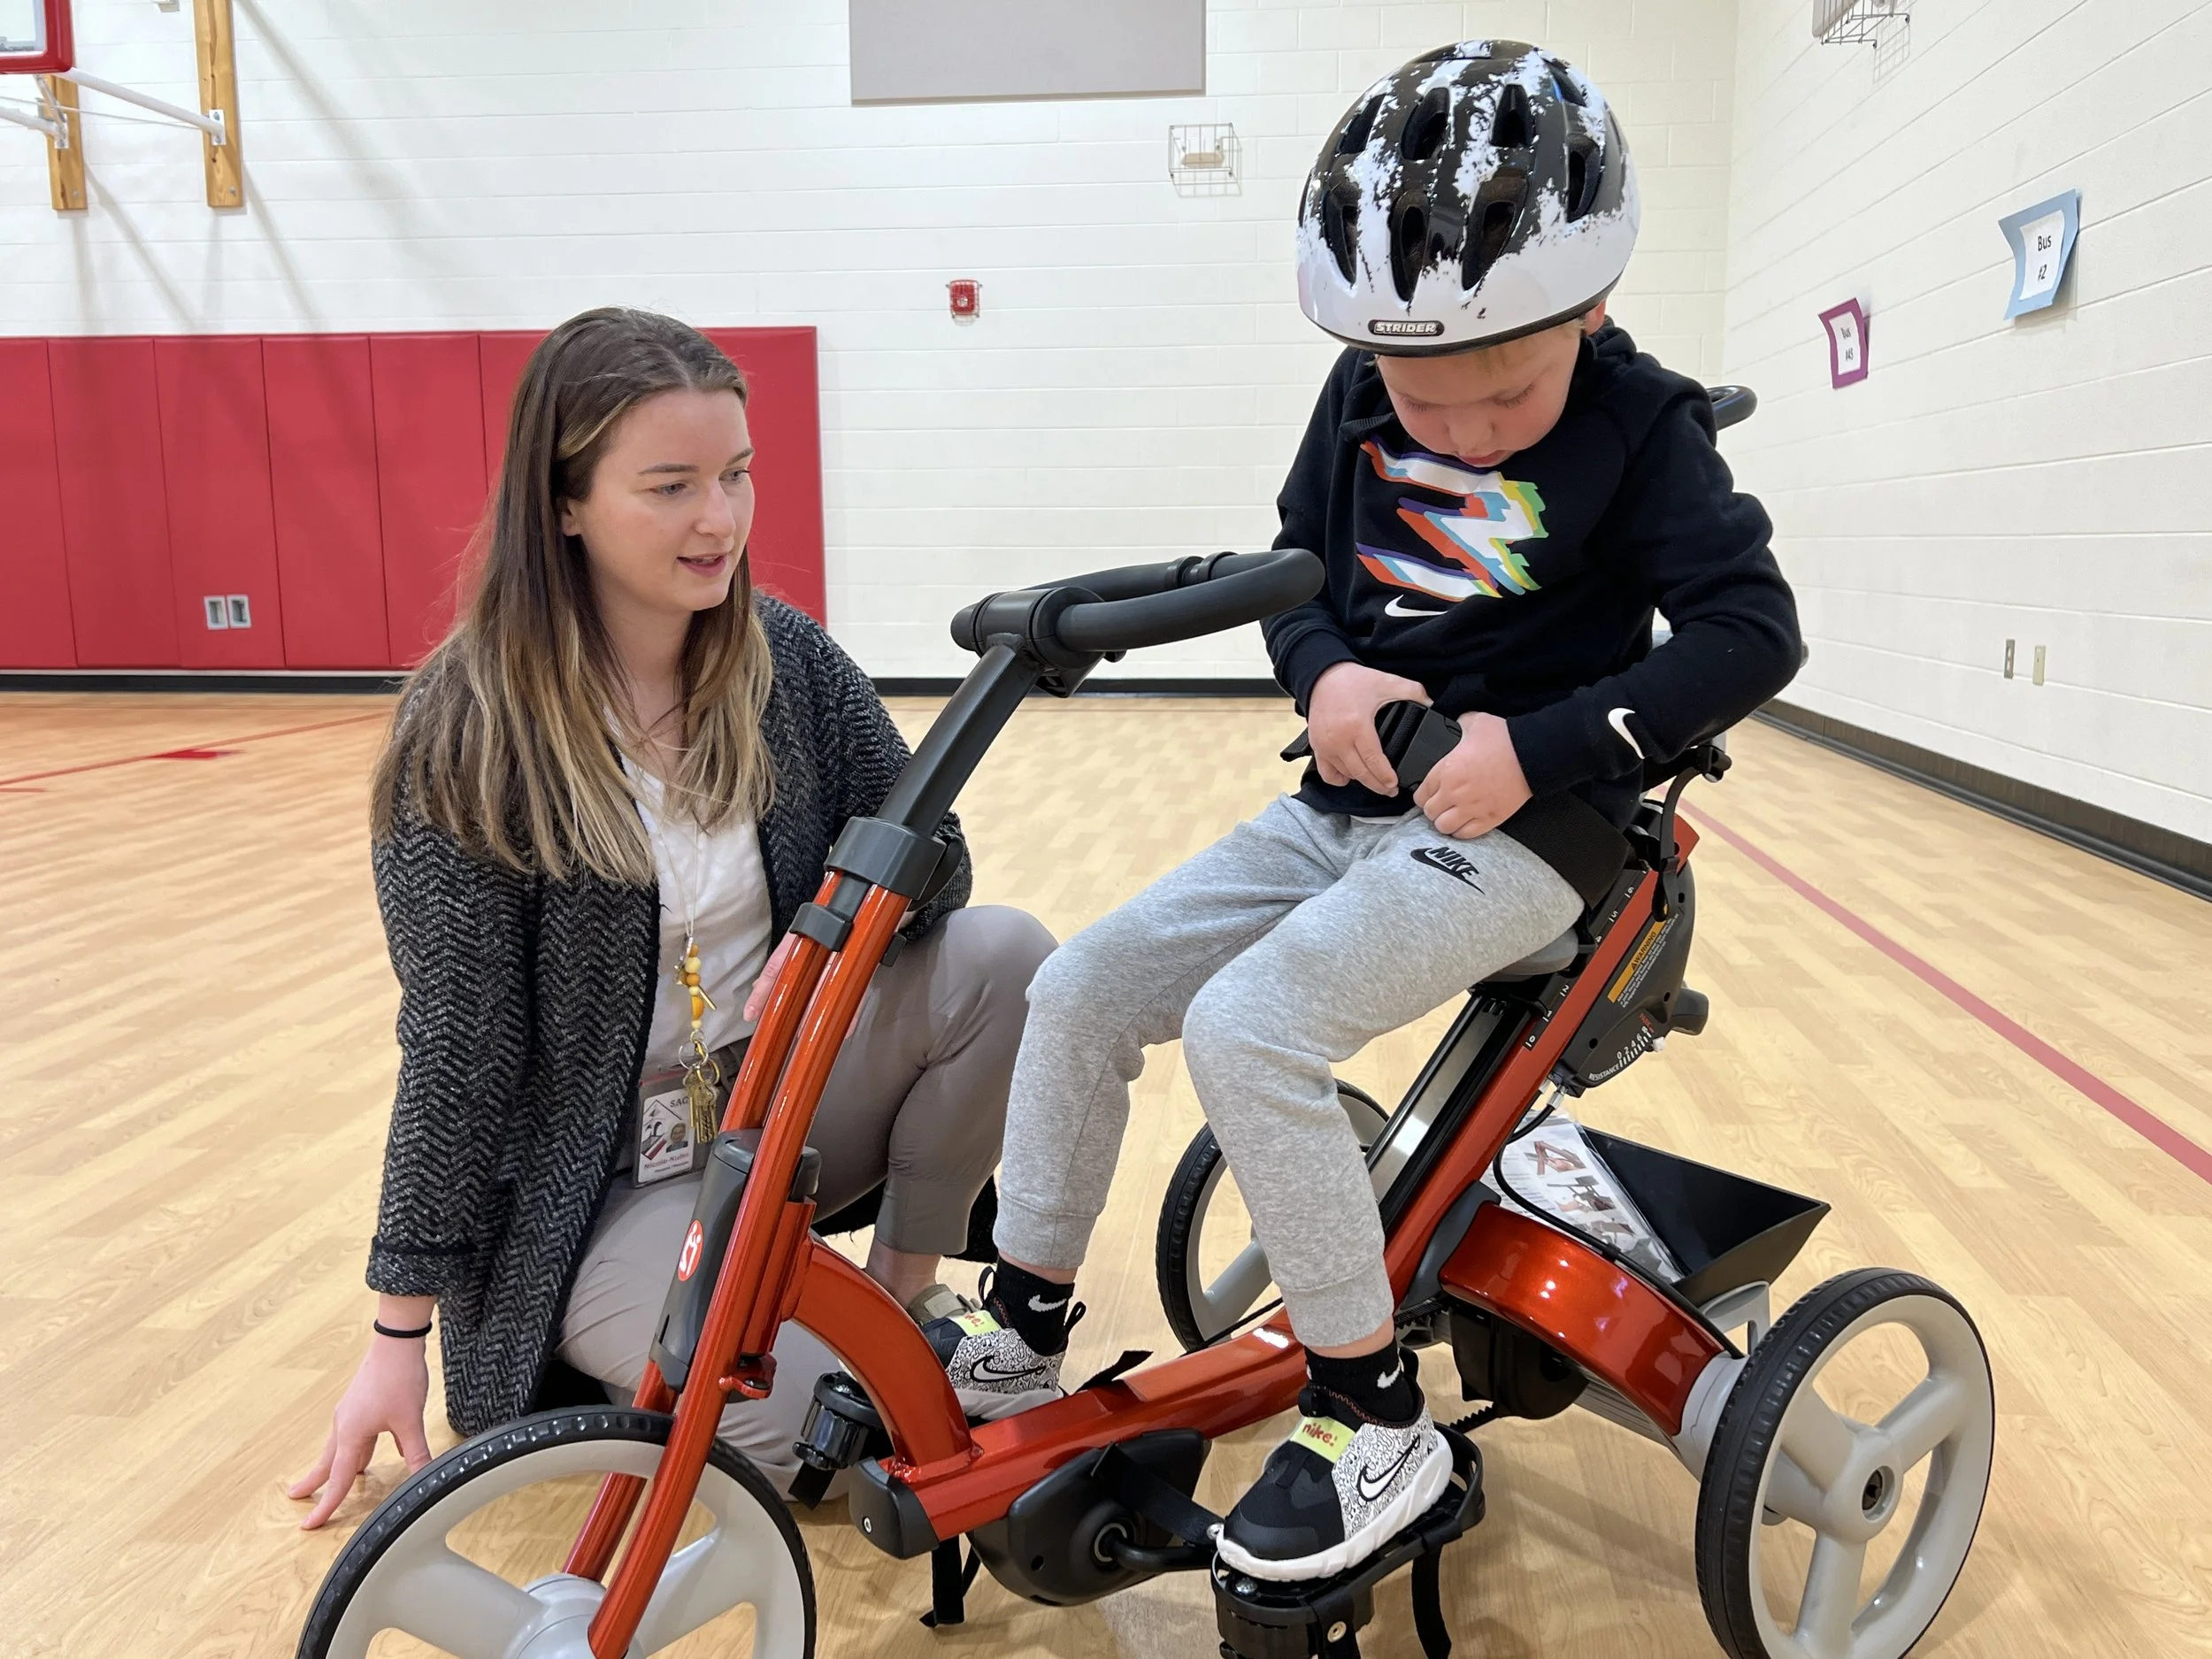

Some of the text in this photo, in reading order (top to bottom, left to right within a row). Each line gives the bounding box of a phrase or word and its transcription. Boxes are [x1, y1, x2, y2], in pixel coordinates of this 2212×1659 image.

[2037, 234, 2052, 251] Bus
[1374, 321, 1438, 334] STRIDER
[1427, 846, 1479, 880] NIKE
[1634, 931, 1656, 964] WARNING
[1562, 984, 1570, 993] 2
[1528, 1034, 1536, 1043] 0
[1624, 1046, 1629, 1055] 2
[1636, 1033, 1642, 1041] 6
[1588, 1063, 1620, 1080] RESISTANCE
